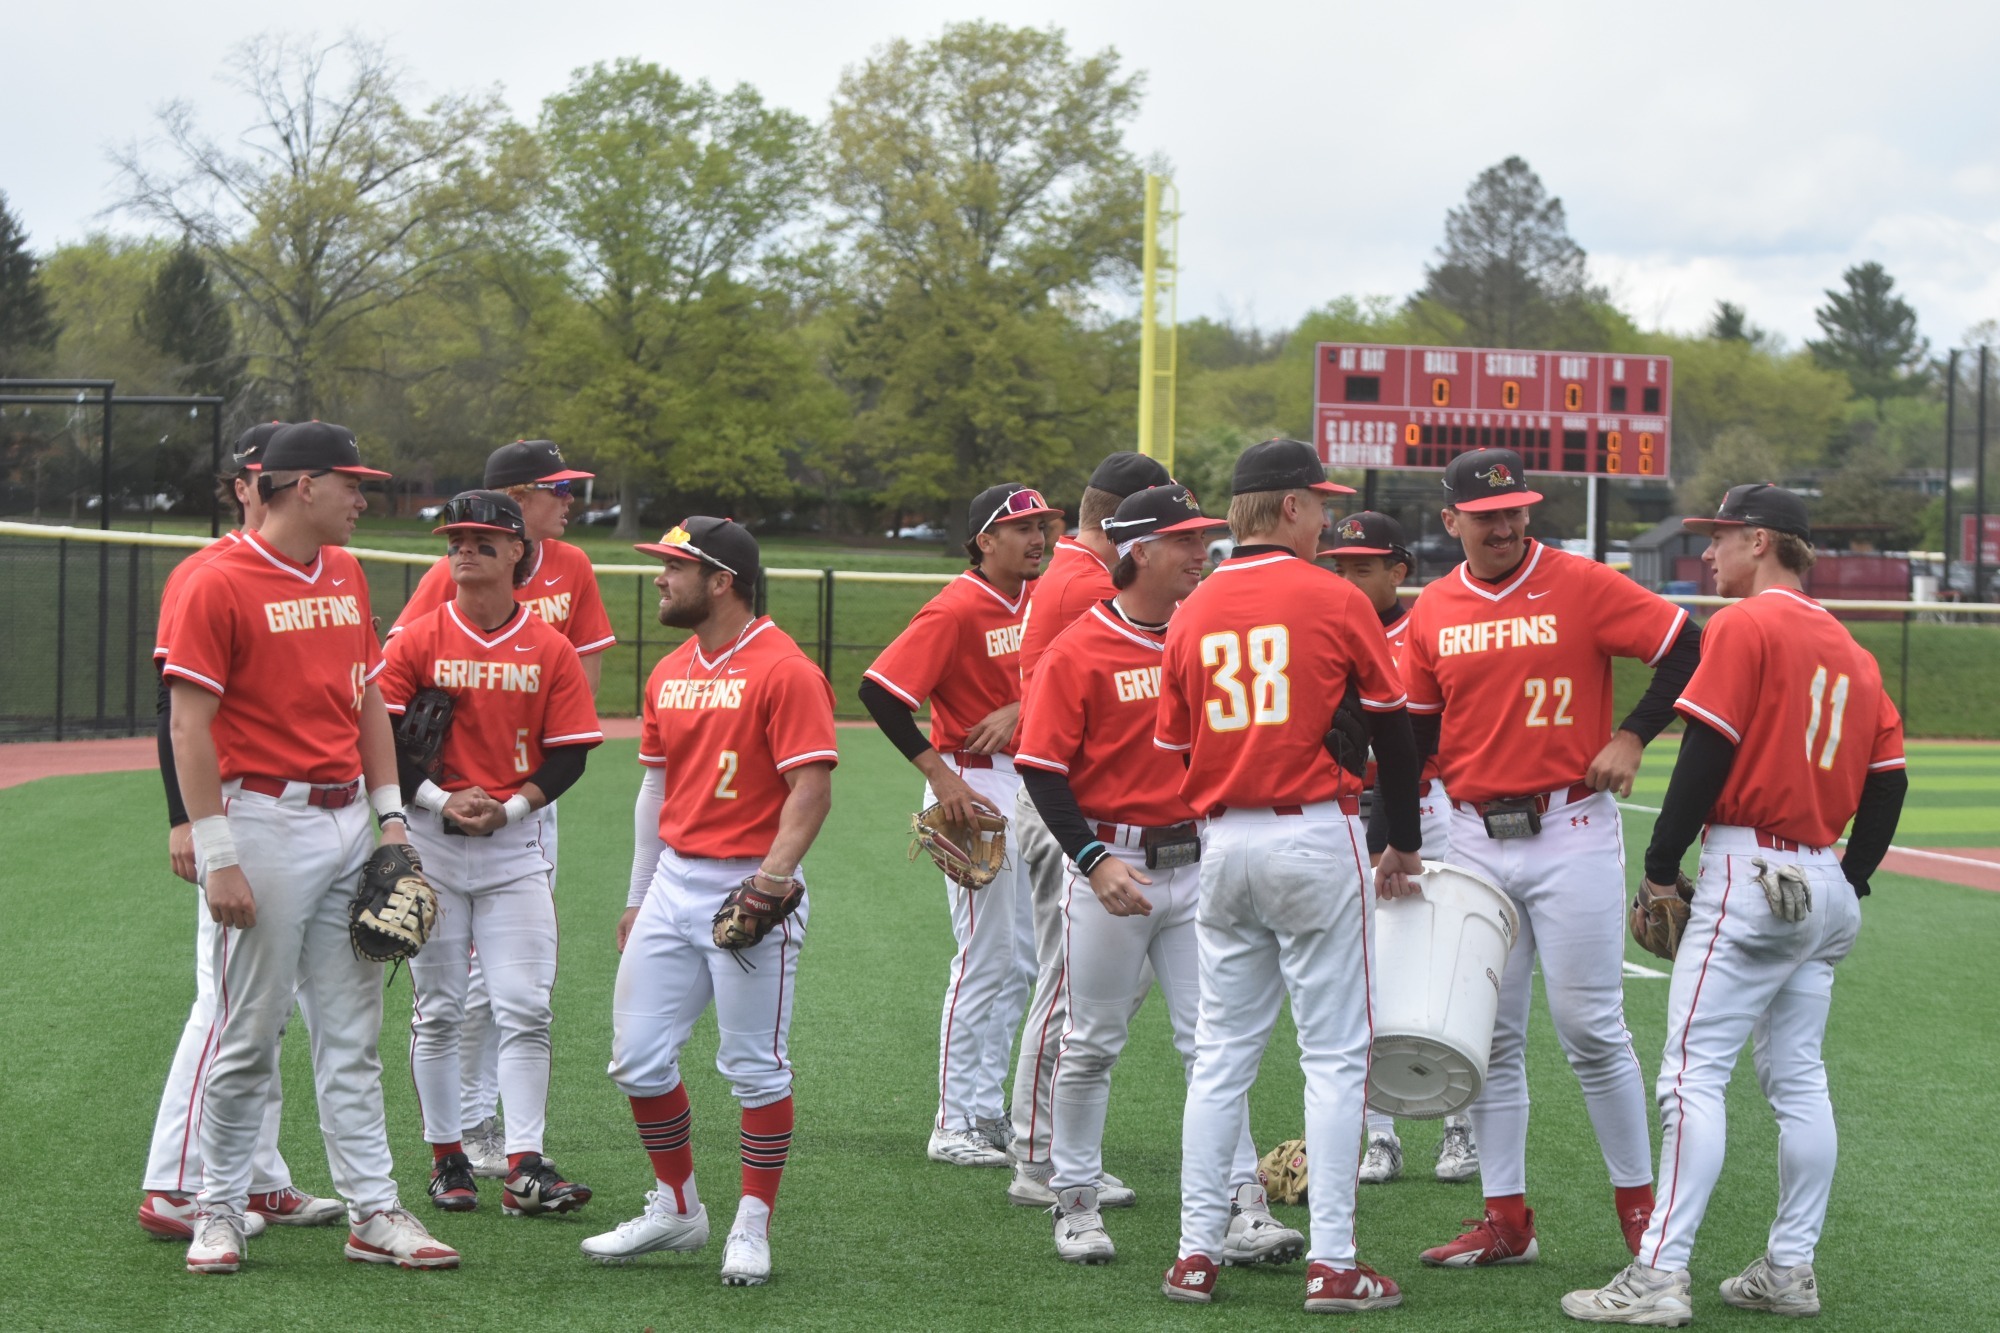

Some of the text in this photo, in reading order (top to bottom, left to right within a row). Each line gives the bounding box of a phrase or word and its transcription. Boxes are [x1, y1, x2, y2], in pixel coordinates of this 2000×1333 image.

[1432, 378, 1450, 407] 0
[1502, 381, 1520, 409] 0
[1565, 383, 1583, 412] 0
[1325, 420, 1397, 444] GUESTS
[1405, 423, 1420, 446] 0
[1328, 442, 1394, 465] GRIFFINS
[264, 595, 360, 633] GRIFFINS
[1439, 614, 1557, 657] GRIFFINS
[434, 660, 540, 692] GRIFFINS
[1200, 624, 1290, 732] 38
[658, 679, 747, 709] GRIFFINS
[1525, 677, 1573, 727] 22
[1805, 664, 1850, 771] 11
[514, 728, 529, 773] 5
[715, 750, 738, 799] 2
